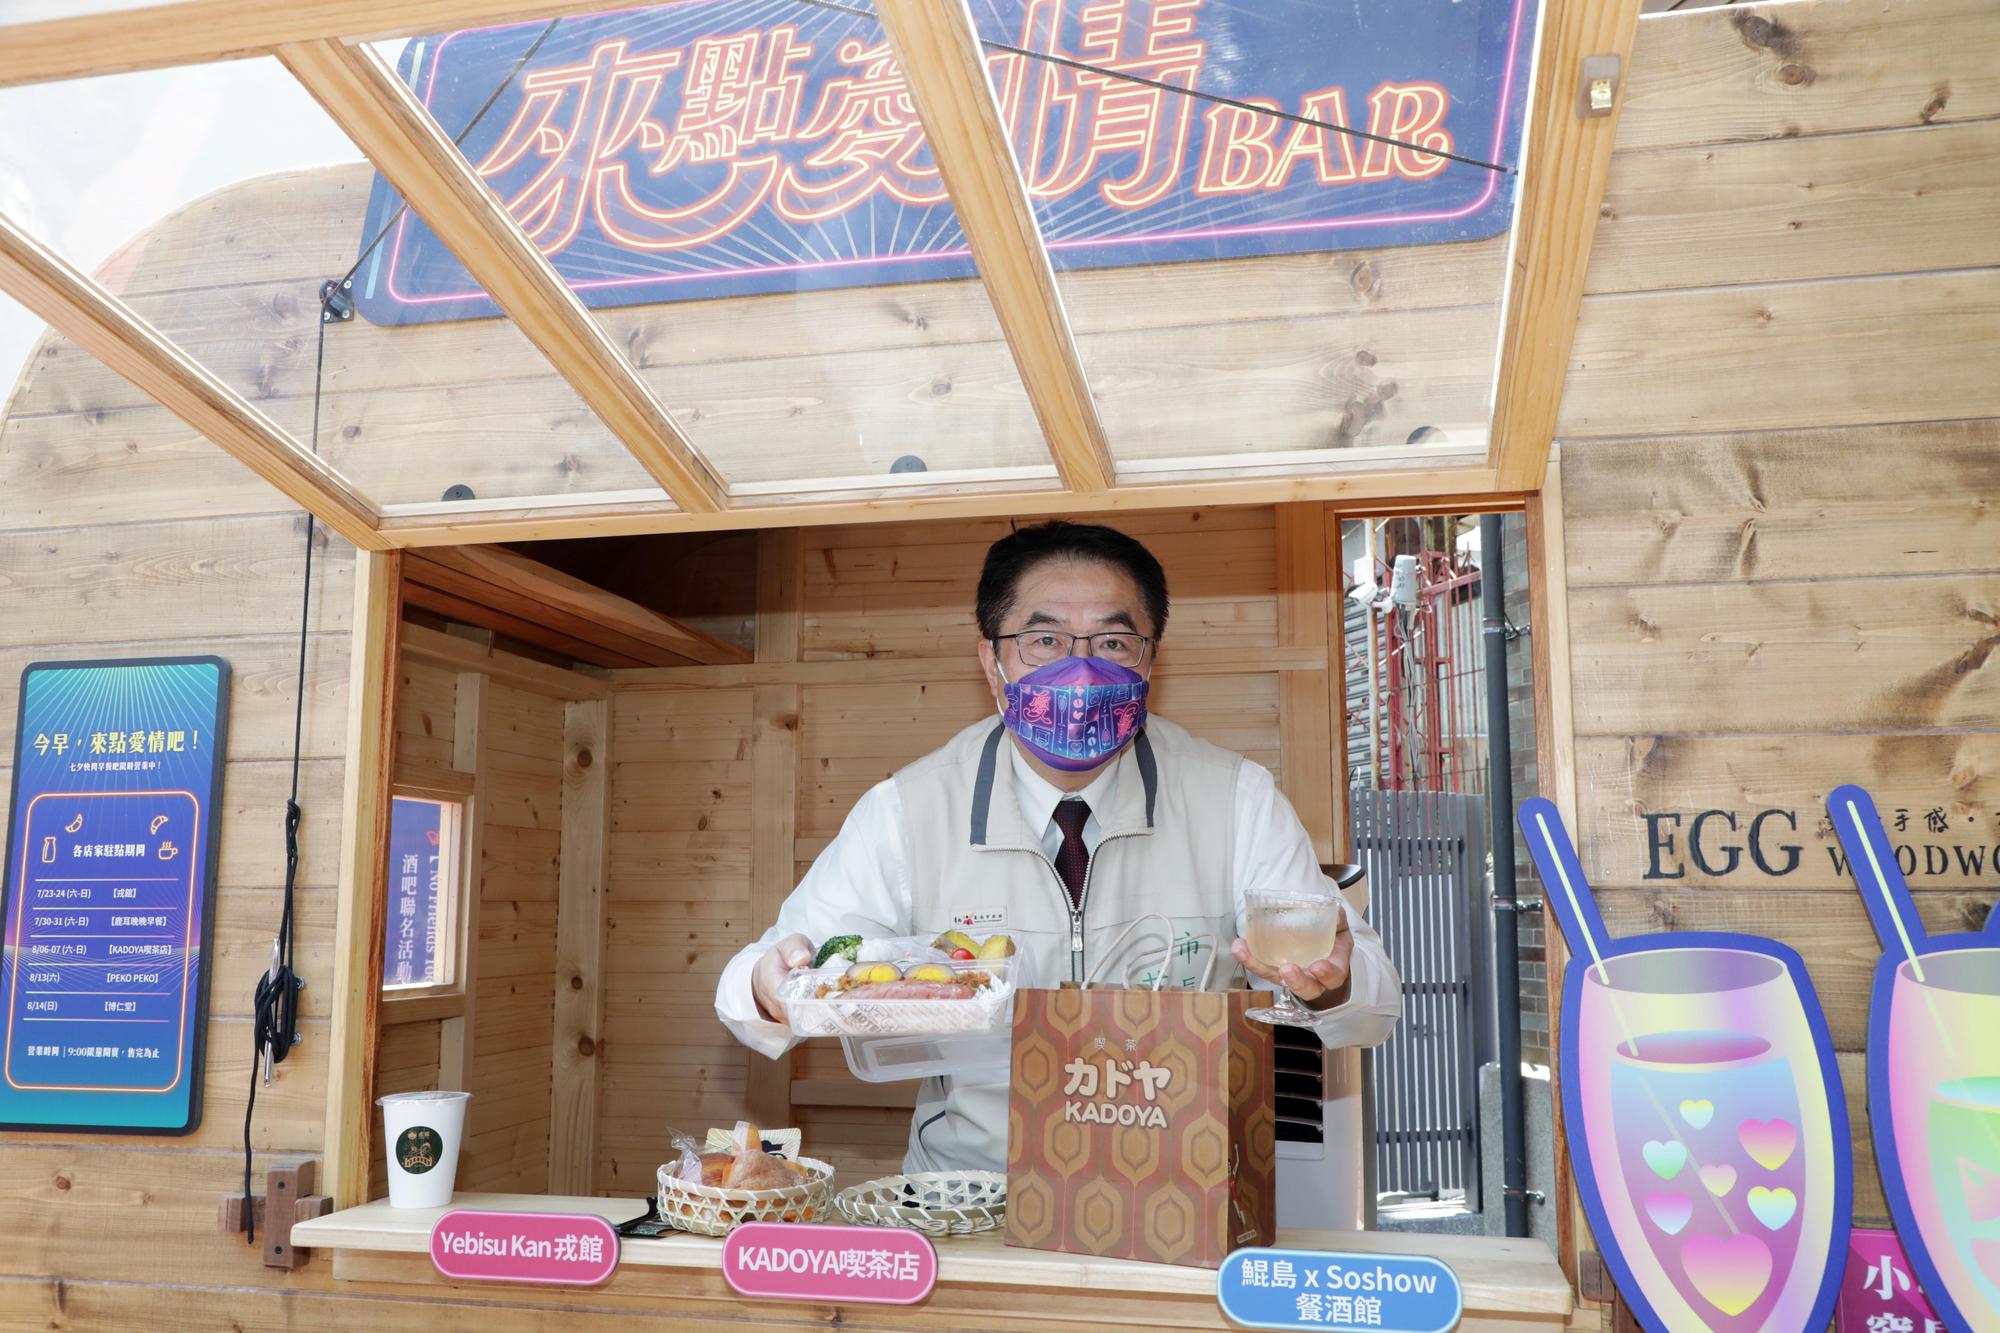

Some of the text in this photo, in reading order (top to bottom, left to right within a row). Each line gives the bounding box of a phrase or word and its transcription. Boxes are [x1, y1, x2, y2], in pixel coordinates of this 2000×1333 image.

[1197, 82, 1455, 194] BAR
[72, 843, 146, 858] 各店家駐點期間
[1640, 809, 1804, 880] EGG
[1827, 844, 2000, 876] WODW
[36, 889, 66, 898] 7/23-24
[66, 888, 91, 899] (六-日)
[34, 917, 63, 926] 7/30-31
[64, 916, 89, 927] (六-日)
[31, 945, 61, 954] 8/06-07
[62, 945, 87, 955] (六-日)
[29, 973, 60, 983] 8/13(六)
[27, 1001, 58, 1011] 8/14(日)
[1063, 1056, 1172, 1101] カドヤ
[1064, 1100, 1168, 1129] KADOYA
[440, 1231, 604, 1263] Yebisu Kan 戎館
[738, 1246, 921, 1282] KADOYA喫茶店
[1241, 1257, 1437, 1294] 鯤島 x Soshow
[1295, 1292, 1382, 1326] 餐酒館
